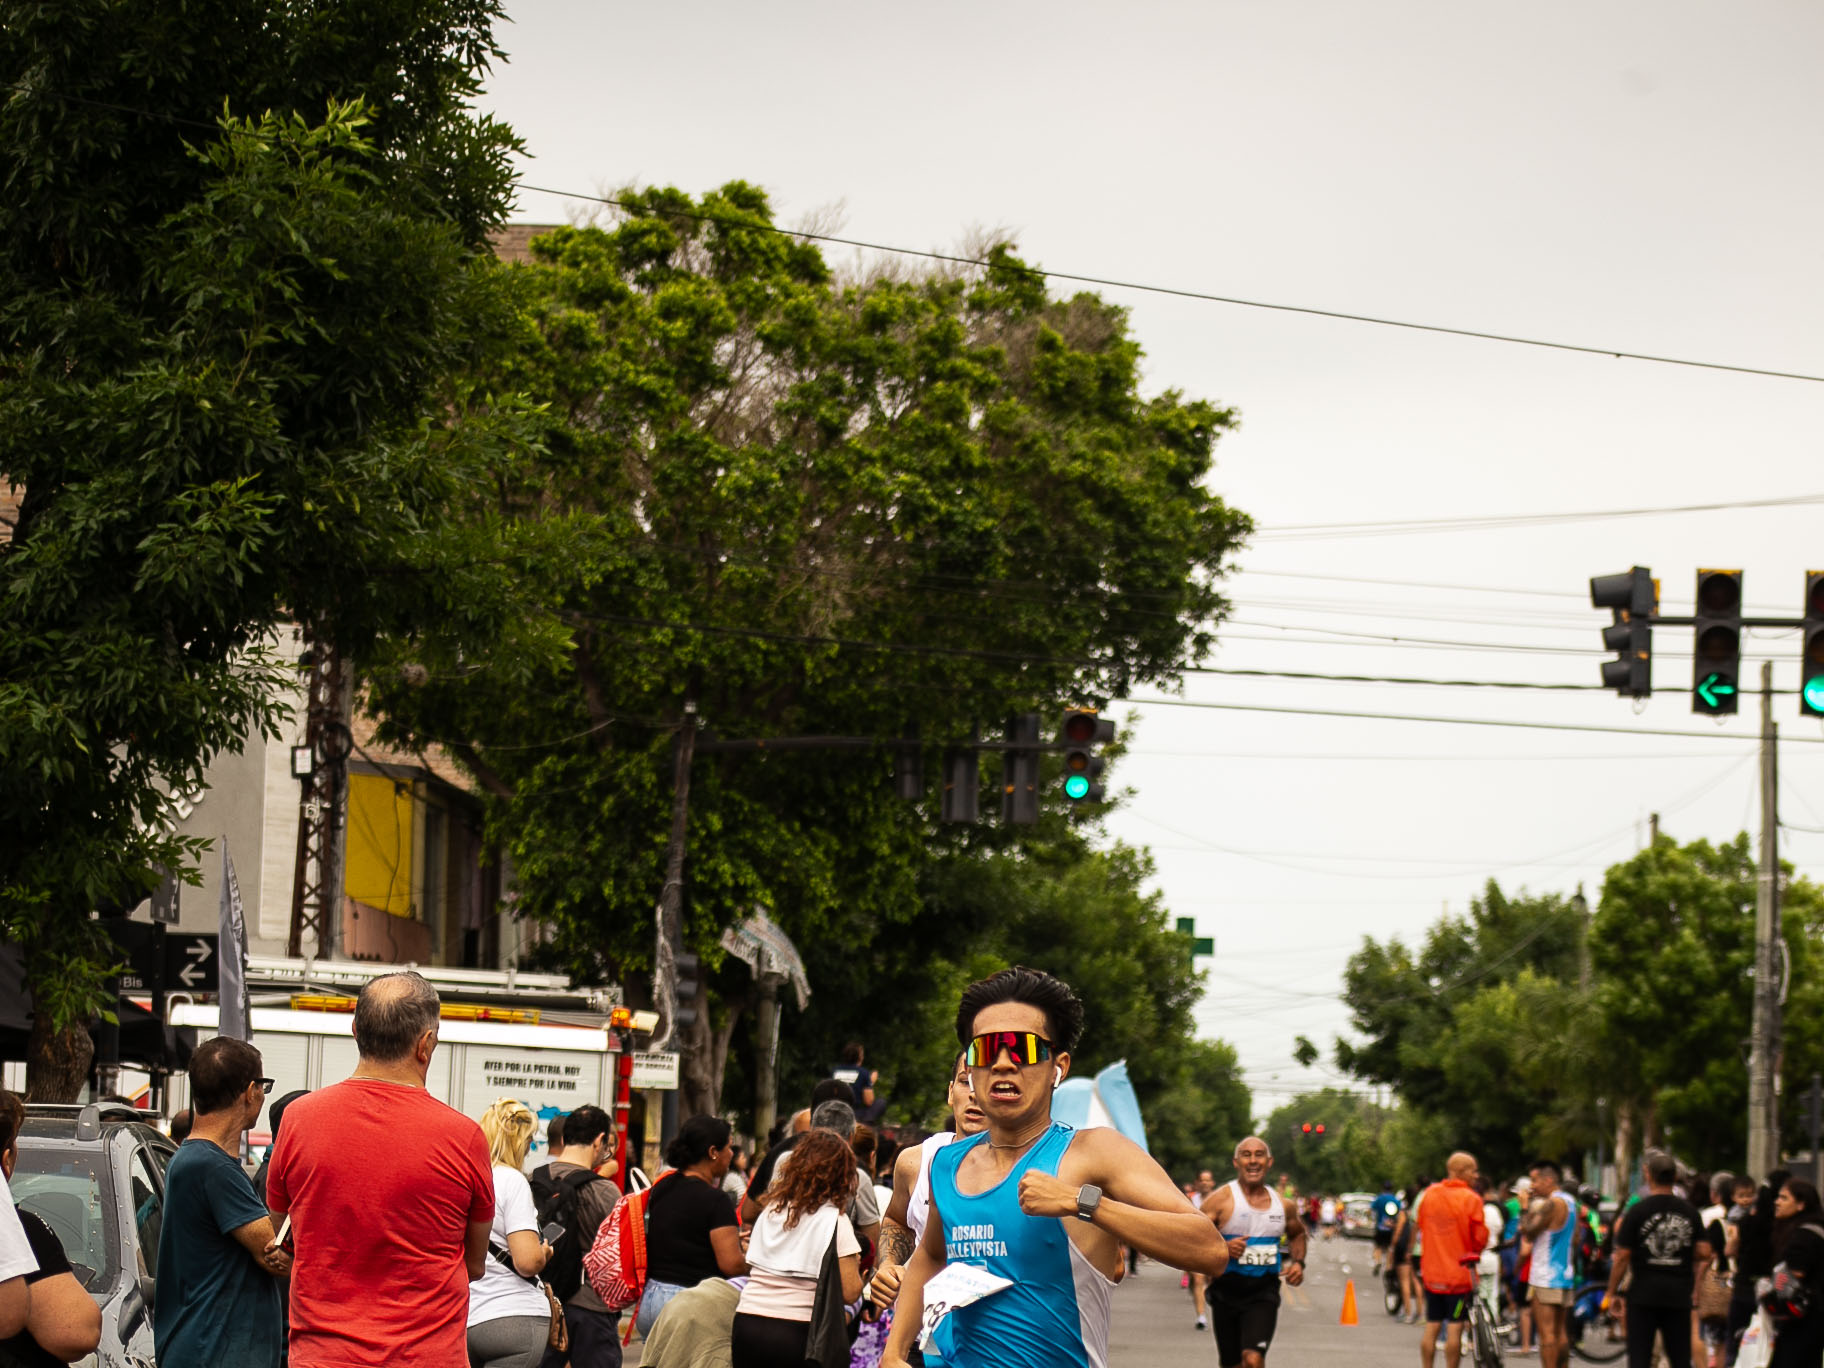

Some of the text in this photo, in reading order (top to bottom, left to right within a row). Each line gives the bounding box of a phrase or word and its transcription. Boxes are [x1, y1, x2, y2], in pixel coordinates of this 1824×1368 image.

[484, 1061, 503, 1071] AYER
[505, 1062, 521, 1073] POR
[523, 1064, 532, 1073] LA
[565, 1066, 581, 1077] HOY
[486, 1076, 577, 1091] Y SIEMPRE POR LA VIDA
[952, 1224, 994, 1241] ROSARIO
[1246, 1253, 1270, 1265] 612
